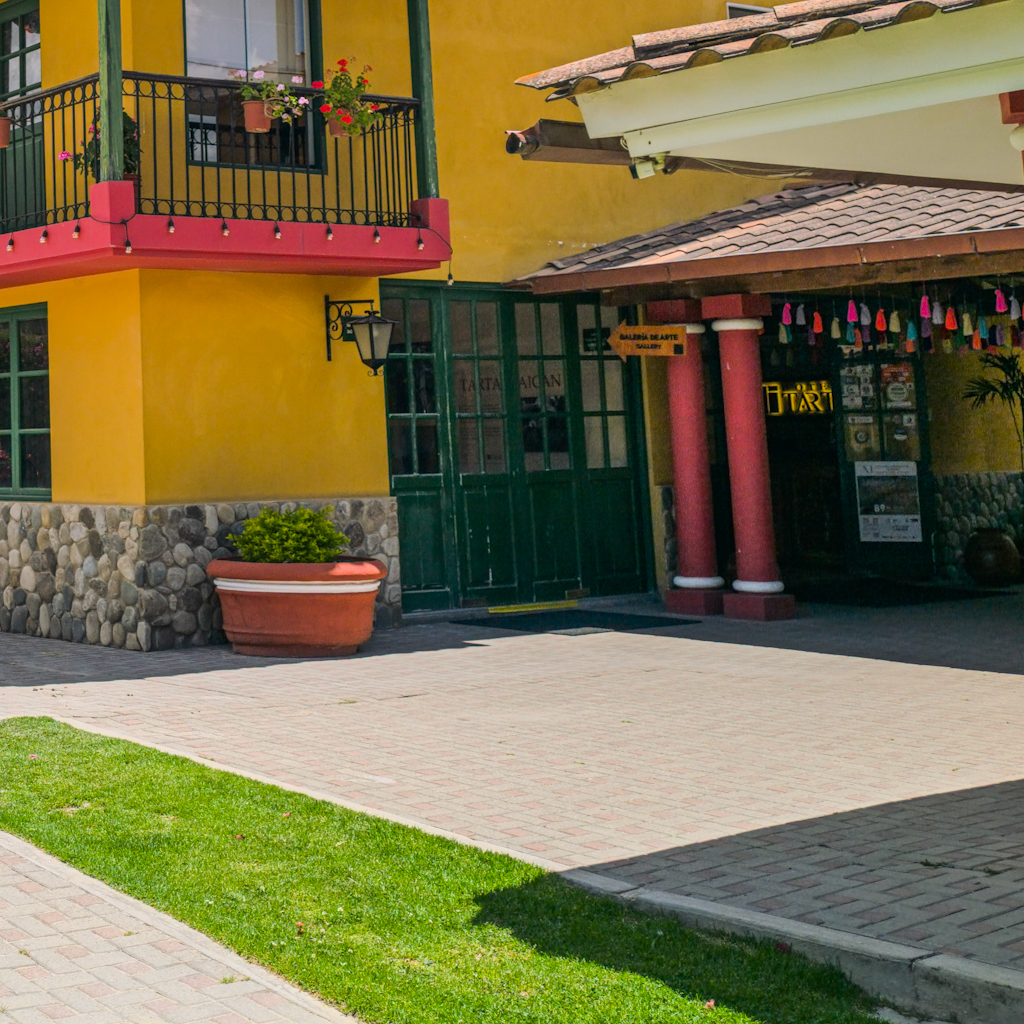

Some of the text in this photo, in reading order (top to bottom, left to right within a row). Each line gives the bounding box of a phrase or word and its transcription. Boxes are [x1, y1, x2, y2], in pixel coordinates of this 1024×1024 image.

[619, 332, 679, 341] GALERÍA DE ARTE
[873, 503, 885, 513] 89
